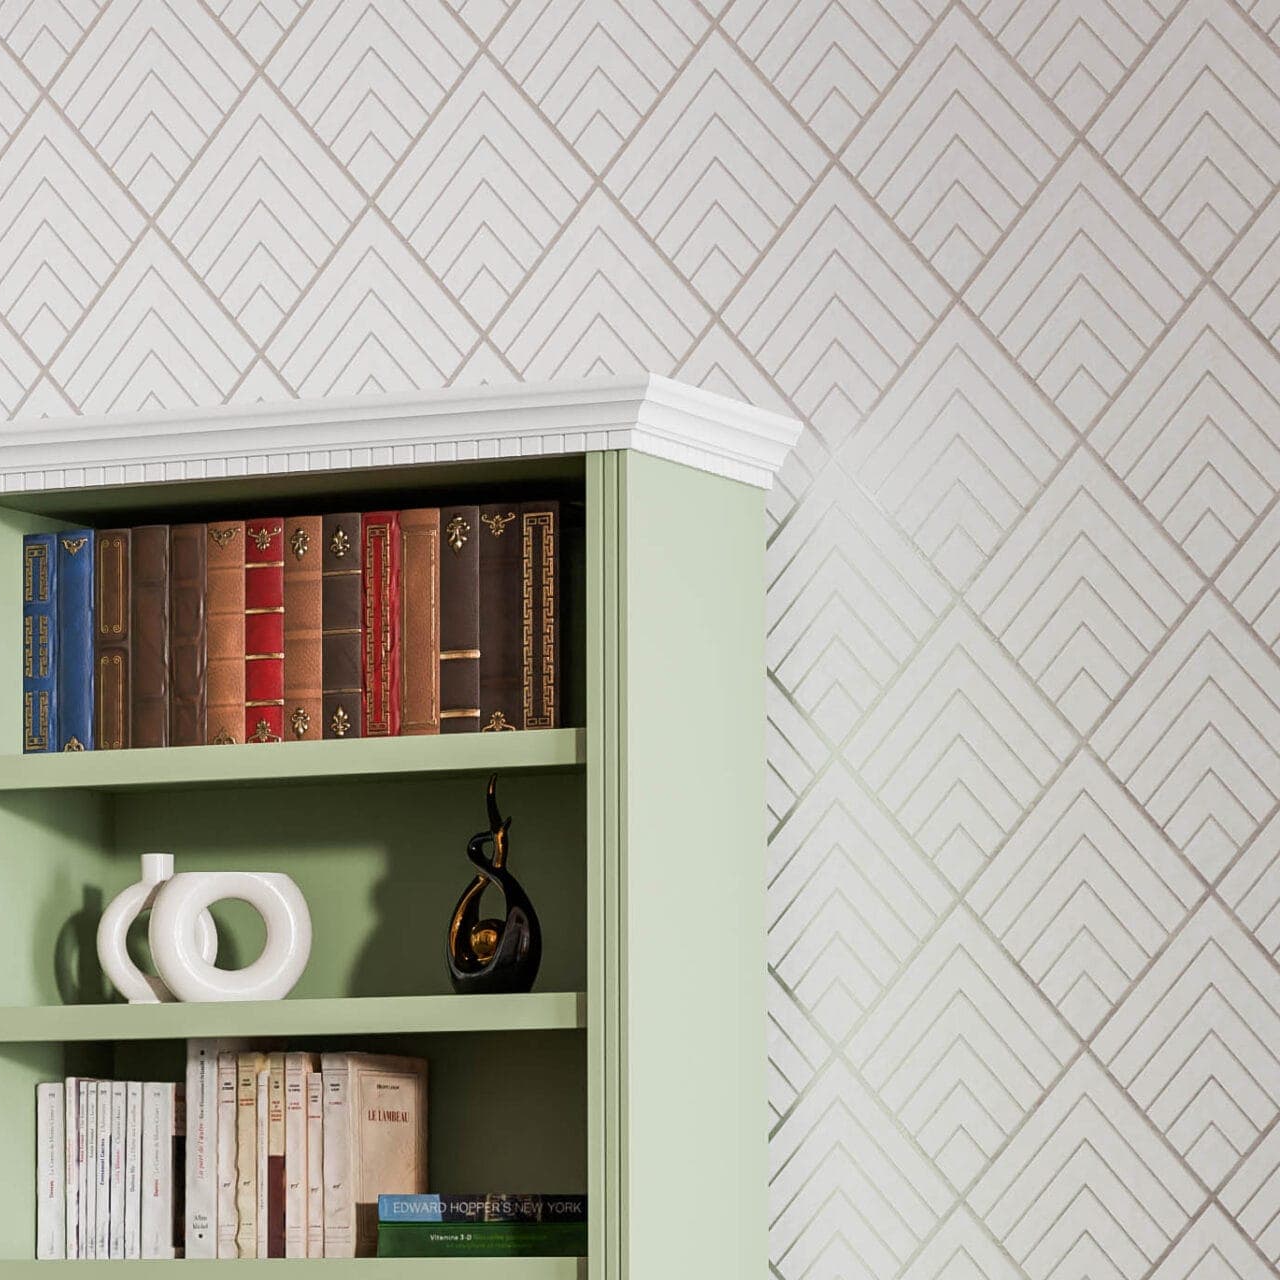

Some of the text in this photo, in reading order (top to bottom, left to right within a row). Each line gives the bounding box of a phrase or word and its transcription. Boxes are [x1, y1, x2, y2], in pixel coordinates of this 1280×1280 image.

[368, 1109, 408, 1122] LE LAMBEAU
[393, 1202, 581, 1213] EDWARD HOPPER'S NEW YORK
